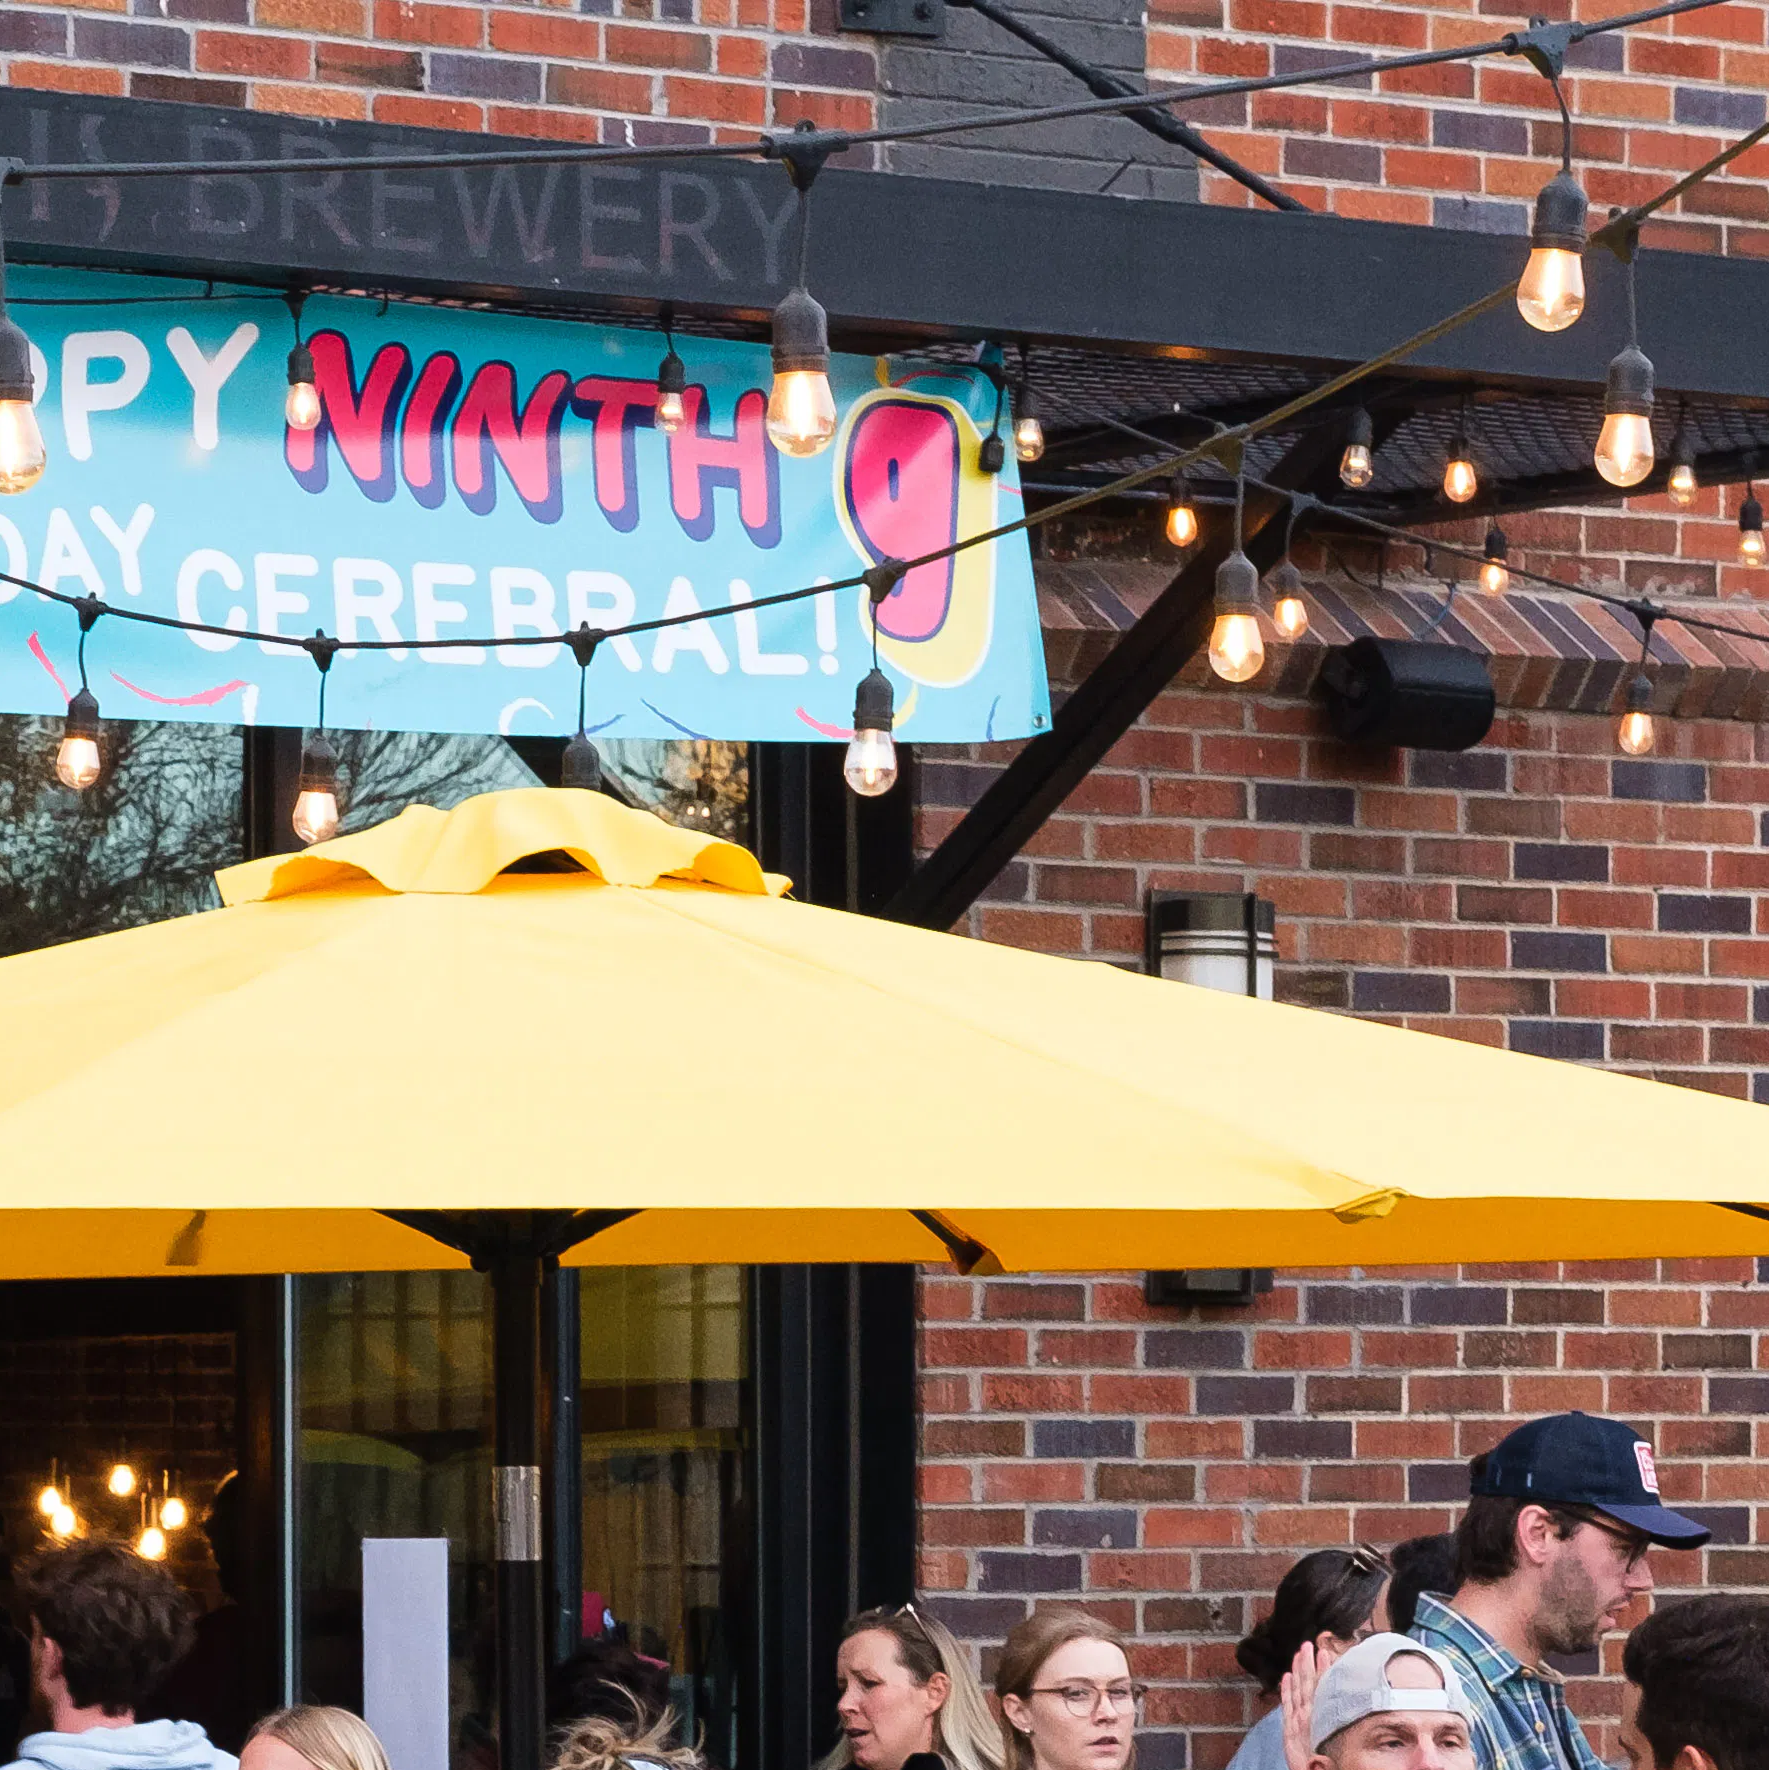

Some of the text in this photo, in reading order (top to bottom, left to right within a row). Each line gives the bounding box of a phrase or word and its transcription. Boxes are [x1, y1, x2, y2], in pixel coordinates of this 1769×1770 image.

[185, 124, 807, 284] BREWERY
[283, 327, 782, 550] NINTH
[175, 547, 839, 677] CEREBRAL!
